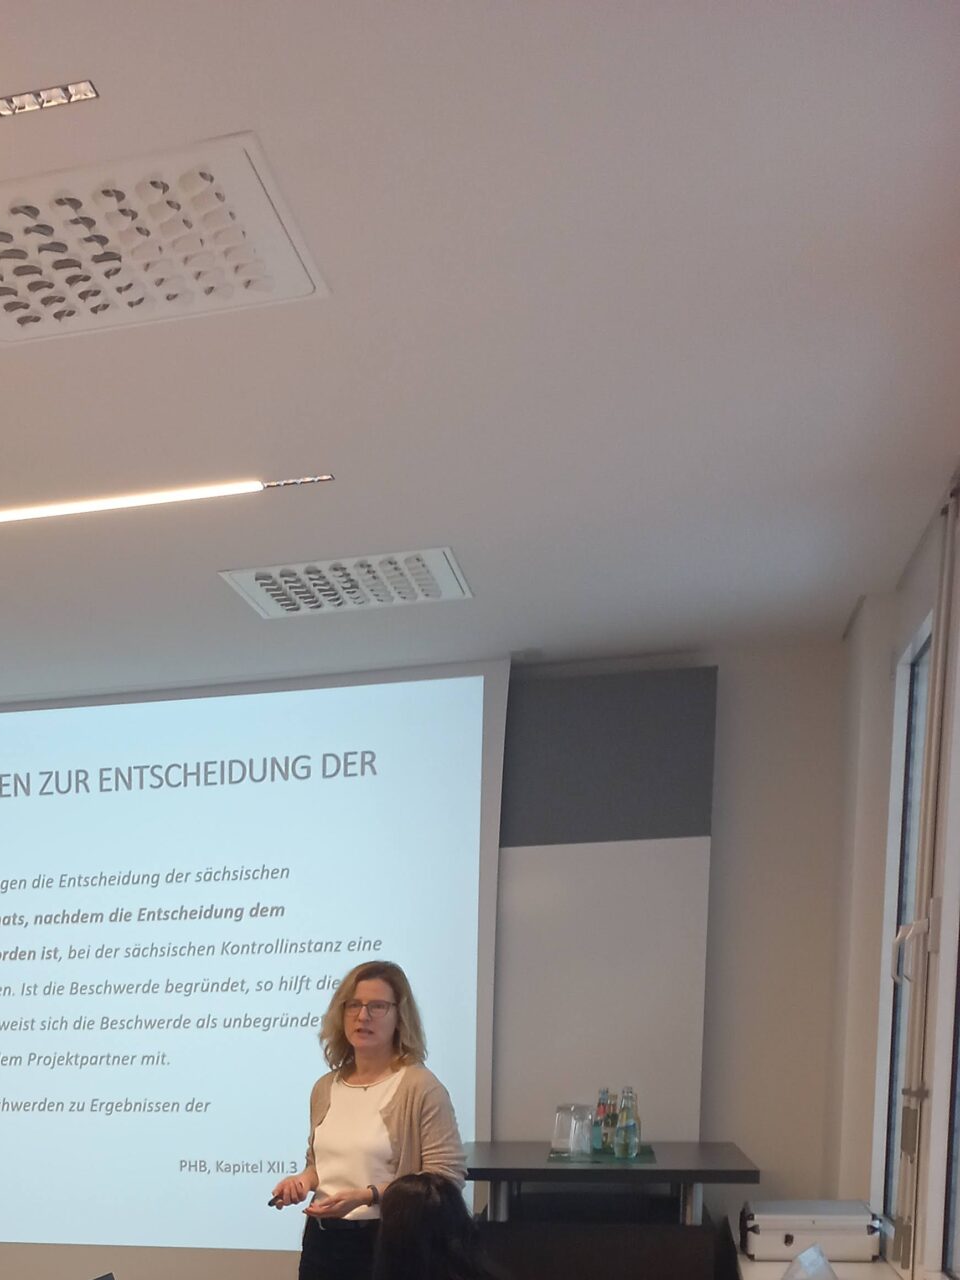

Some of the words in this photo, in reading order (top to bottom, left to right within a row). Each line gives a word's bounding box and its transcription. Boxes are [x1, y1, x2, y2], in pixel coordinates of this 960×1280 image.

[39, 769, 91, 796] ZUR
[99, 754, 311, 792] ENTSCHEIDUNG
[321, 750, 378, 779] DER
[32, 874, 54, 889] die
[59, 869, 161, 889] Entscheidung
[165, 868, 191, 884] der
[195, 864, 291, 883] sächsischen
[34, 909, 104, 926] nachdem
[109, 908, 132, 922] die
[137, 905, 244, 922] Entscheidung
[249, 902, 285, 918] dem
[41, 946, 63, 962] ist,
[68, 946, 90, 960] bei
[95, 944, 121, 959] der
[124, 942, 215, 958] sächsischen
[221, 936, 341, 956] Kontrollinstanz
[348, 935, 382, 952] eine
[21, 982, 38, 997] Ist
[43, 981, 65, 996] die
[69, 980, 160, 996] Beschwerde
[165, 978, 250, 995] begründet,
[256, 979, 274, 992] so
[278, 975, 311, 994] hilft
[316, 974, 342, 991] die
[39, 1016, 69, 1031] sich
[73, 1016, 96, 1030] die
[100, 1014, 192, 1030] Beschwerde
[196, 1014, 218, 1029] als
[222, 1011, 322, 1031] unbegründe
[28, 1051, 136, 1069] Projektpartner
[141, 1051, 171, 1067] mit.
[69, 1102, 85, 1112] zu
[90, 1098, 180, 1116] Ergebnissen
[185, 1099, 211, 1113] der
[179, 1160, 212, 1174] PHB,
[216, 1160, 262, 1176] Kapitel
[267, 1161, 298, 1174] XII.3
